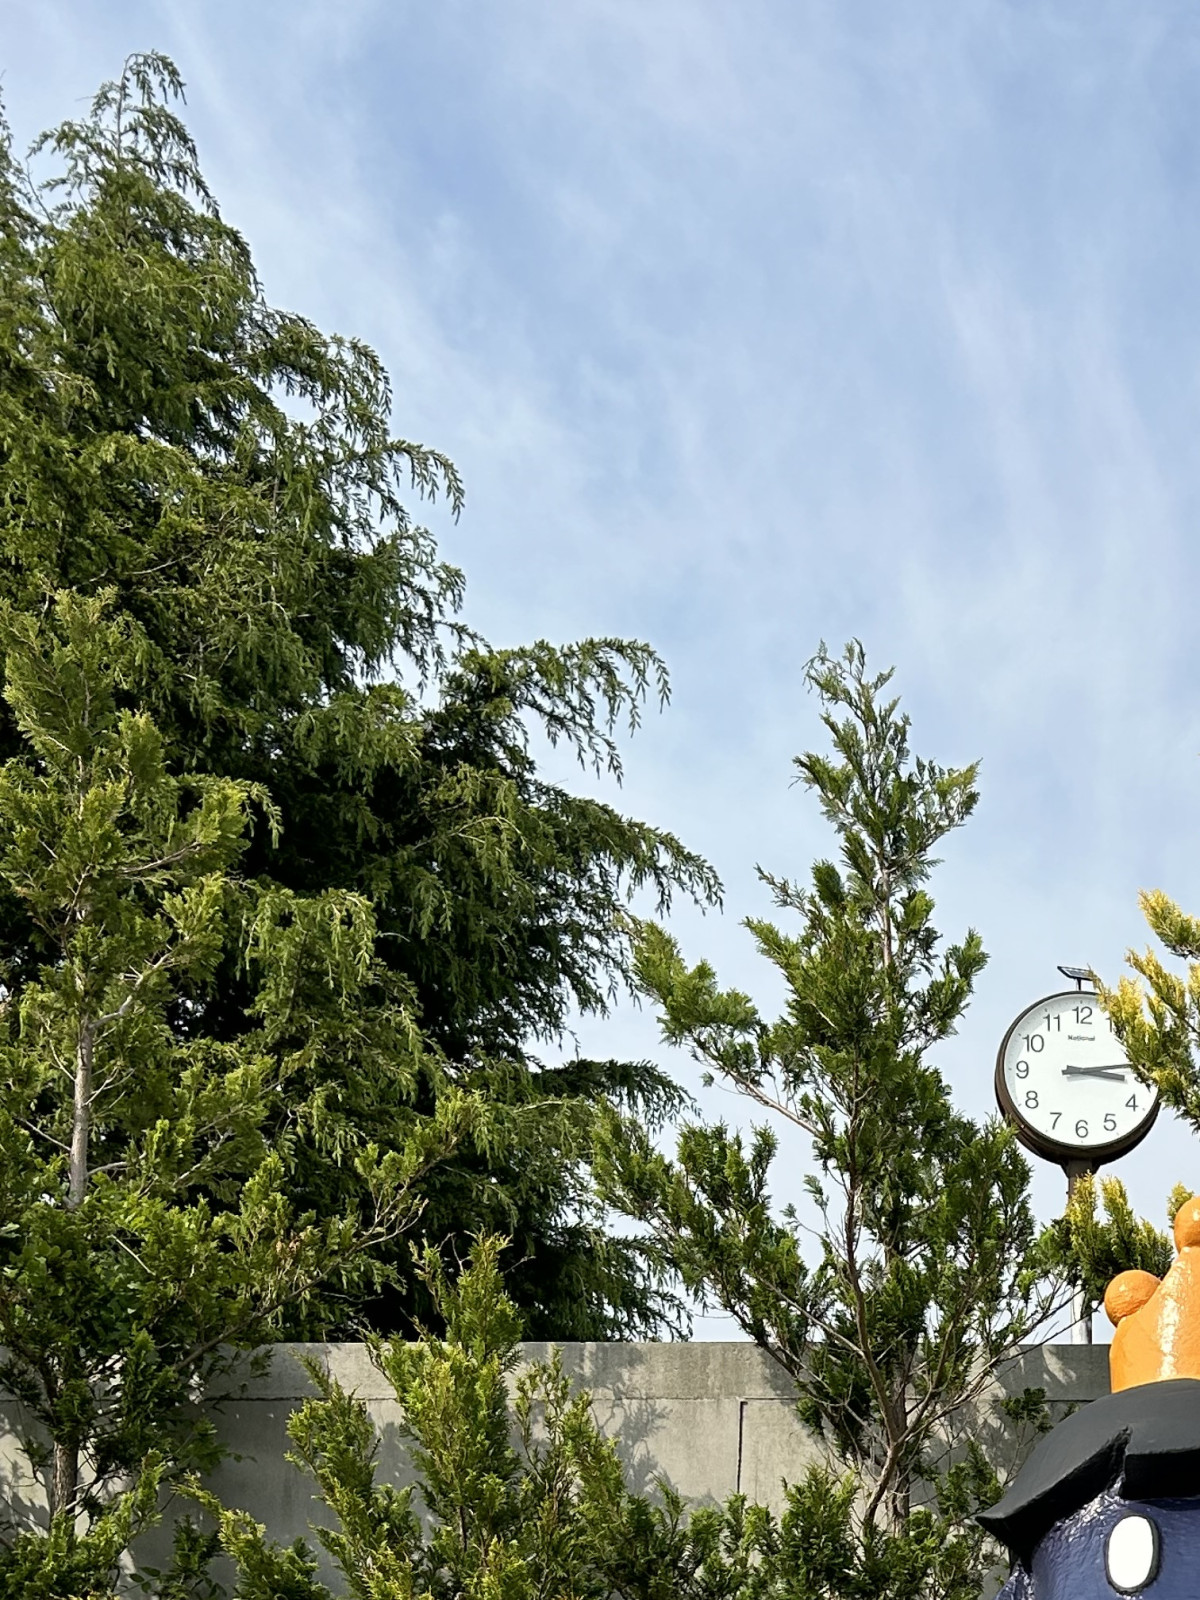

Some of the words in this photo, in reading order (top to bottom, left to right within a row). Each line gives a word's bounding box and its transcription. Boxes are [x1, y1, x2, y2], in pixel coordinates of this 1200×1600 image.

[1043, 1013, 1061, 1032] 11
[1072, 1006, 1093, 1025] 12
[1022, 1034, 1045, 1053] 10
[1016, 1060, 1029, 1079] 9
[1025, 1090, 1039, 1109] 8
[1125, 1094, 1139, 1112] 4
[1050, 1112, 1062, 1130] 7
[1075, 1119, 1089, 1138] 6
[1103, 1113, 1117, 1131] 5
